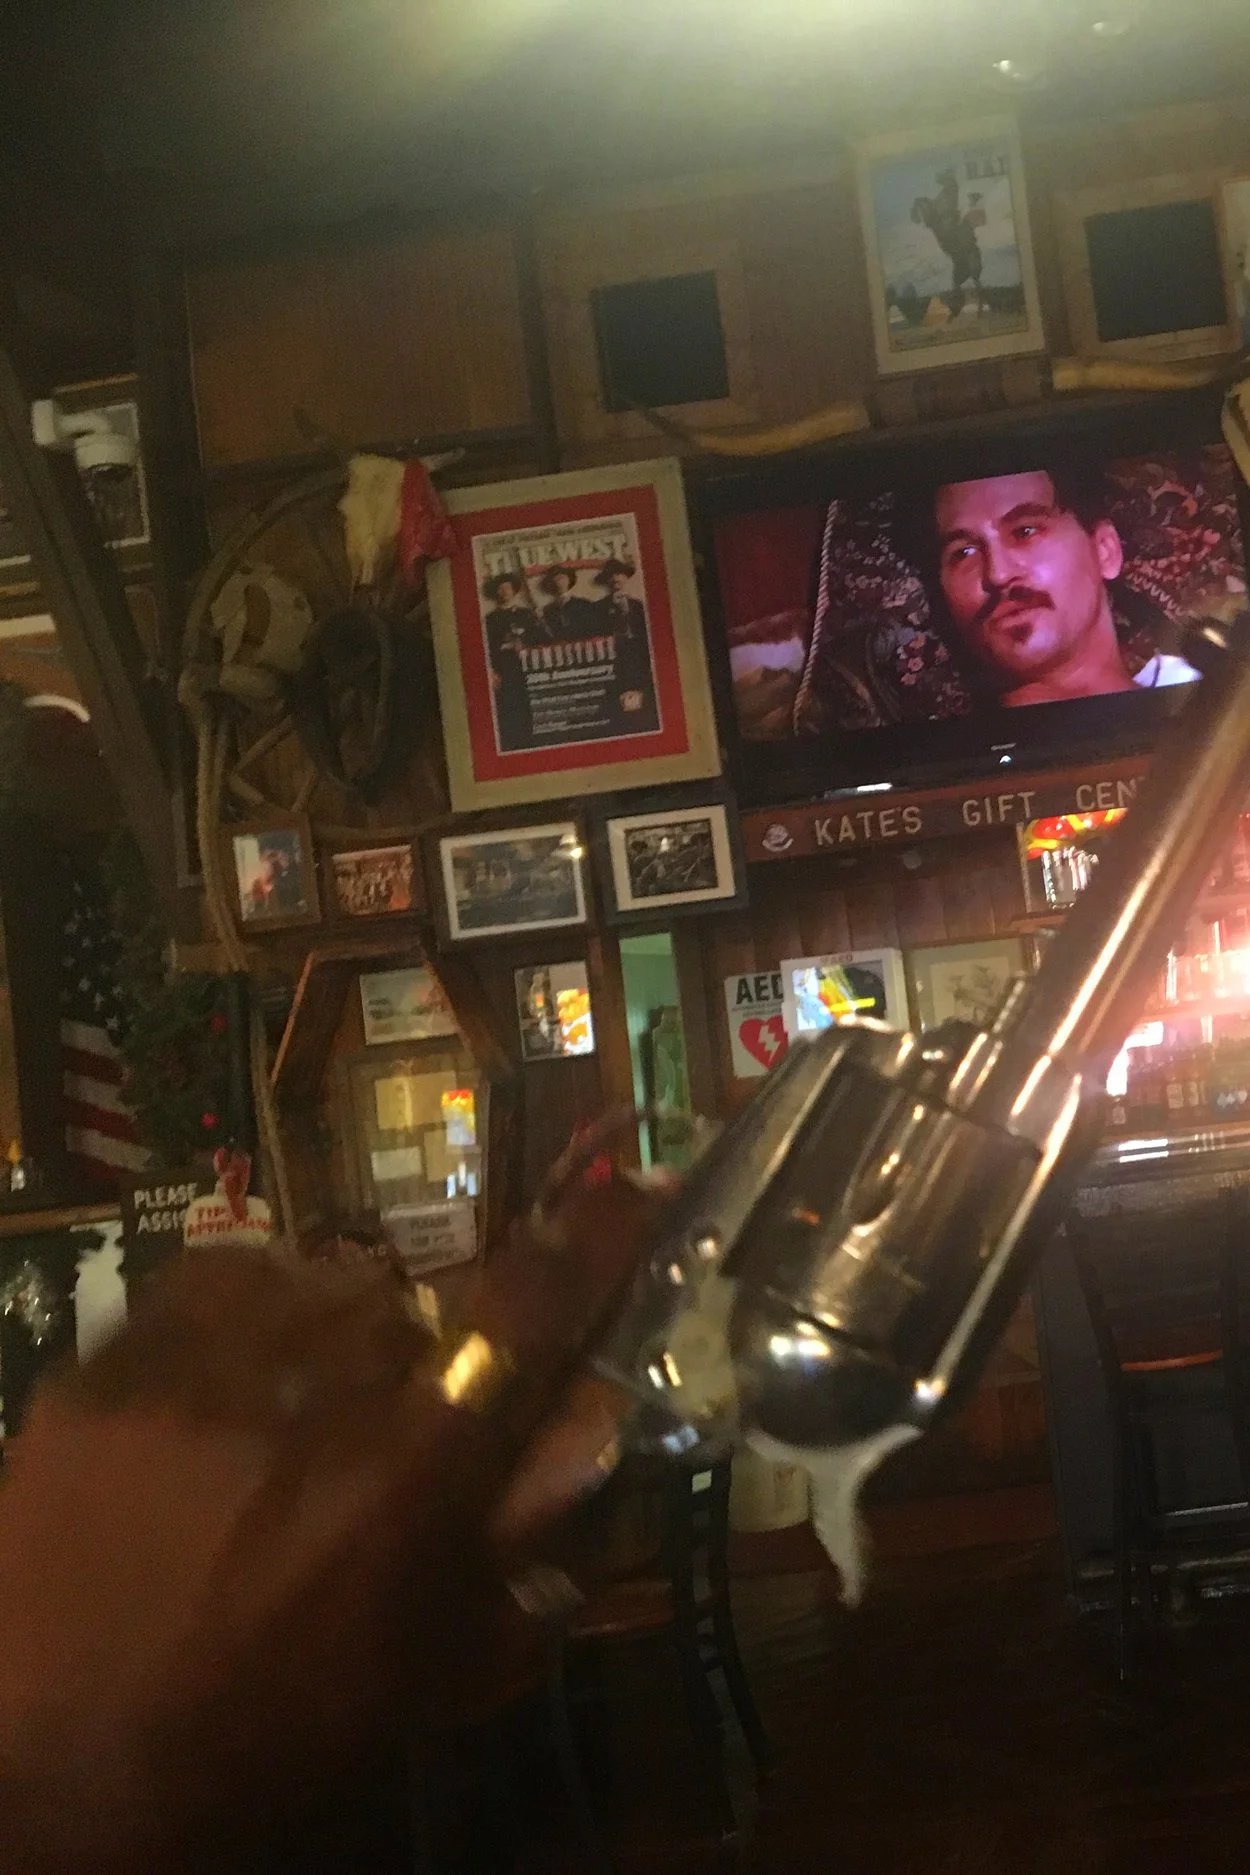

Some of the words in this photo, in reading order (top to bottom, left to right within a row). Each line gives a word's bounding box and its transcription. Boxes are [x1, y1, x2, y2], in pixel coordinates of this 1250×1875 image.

[814, 805, 923, 846] KATE'S
[962, 791, 1036, 827] GIFT
[1075, 777, 1146, 812] CEN
[736, 974, 783, 1005] AED
[134, 1182, 197, 1211] PLEASE
